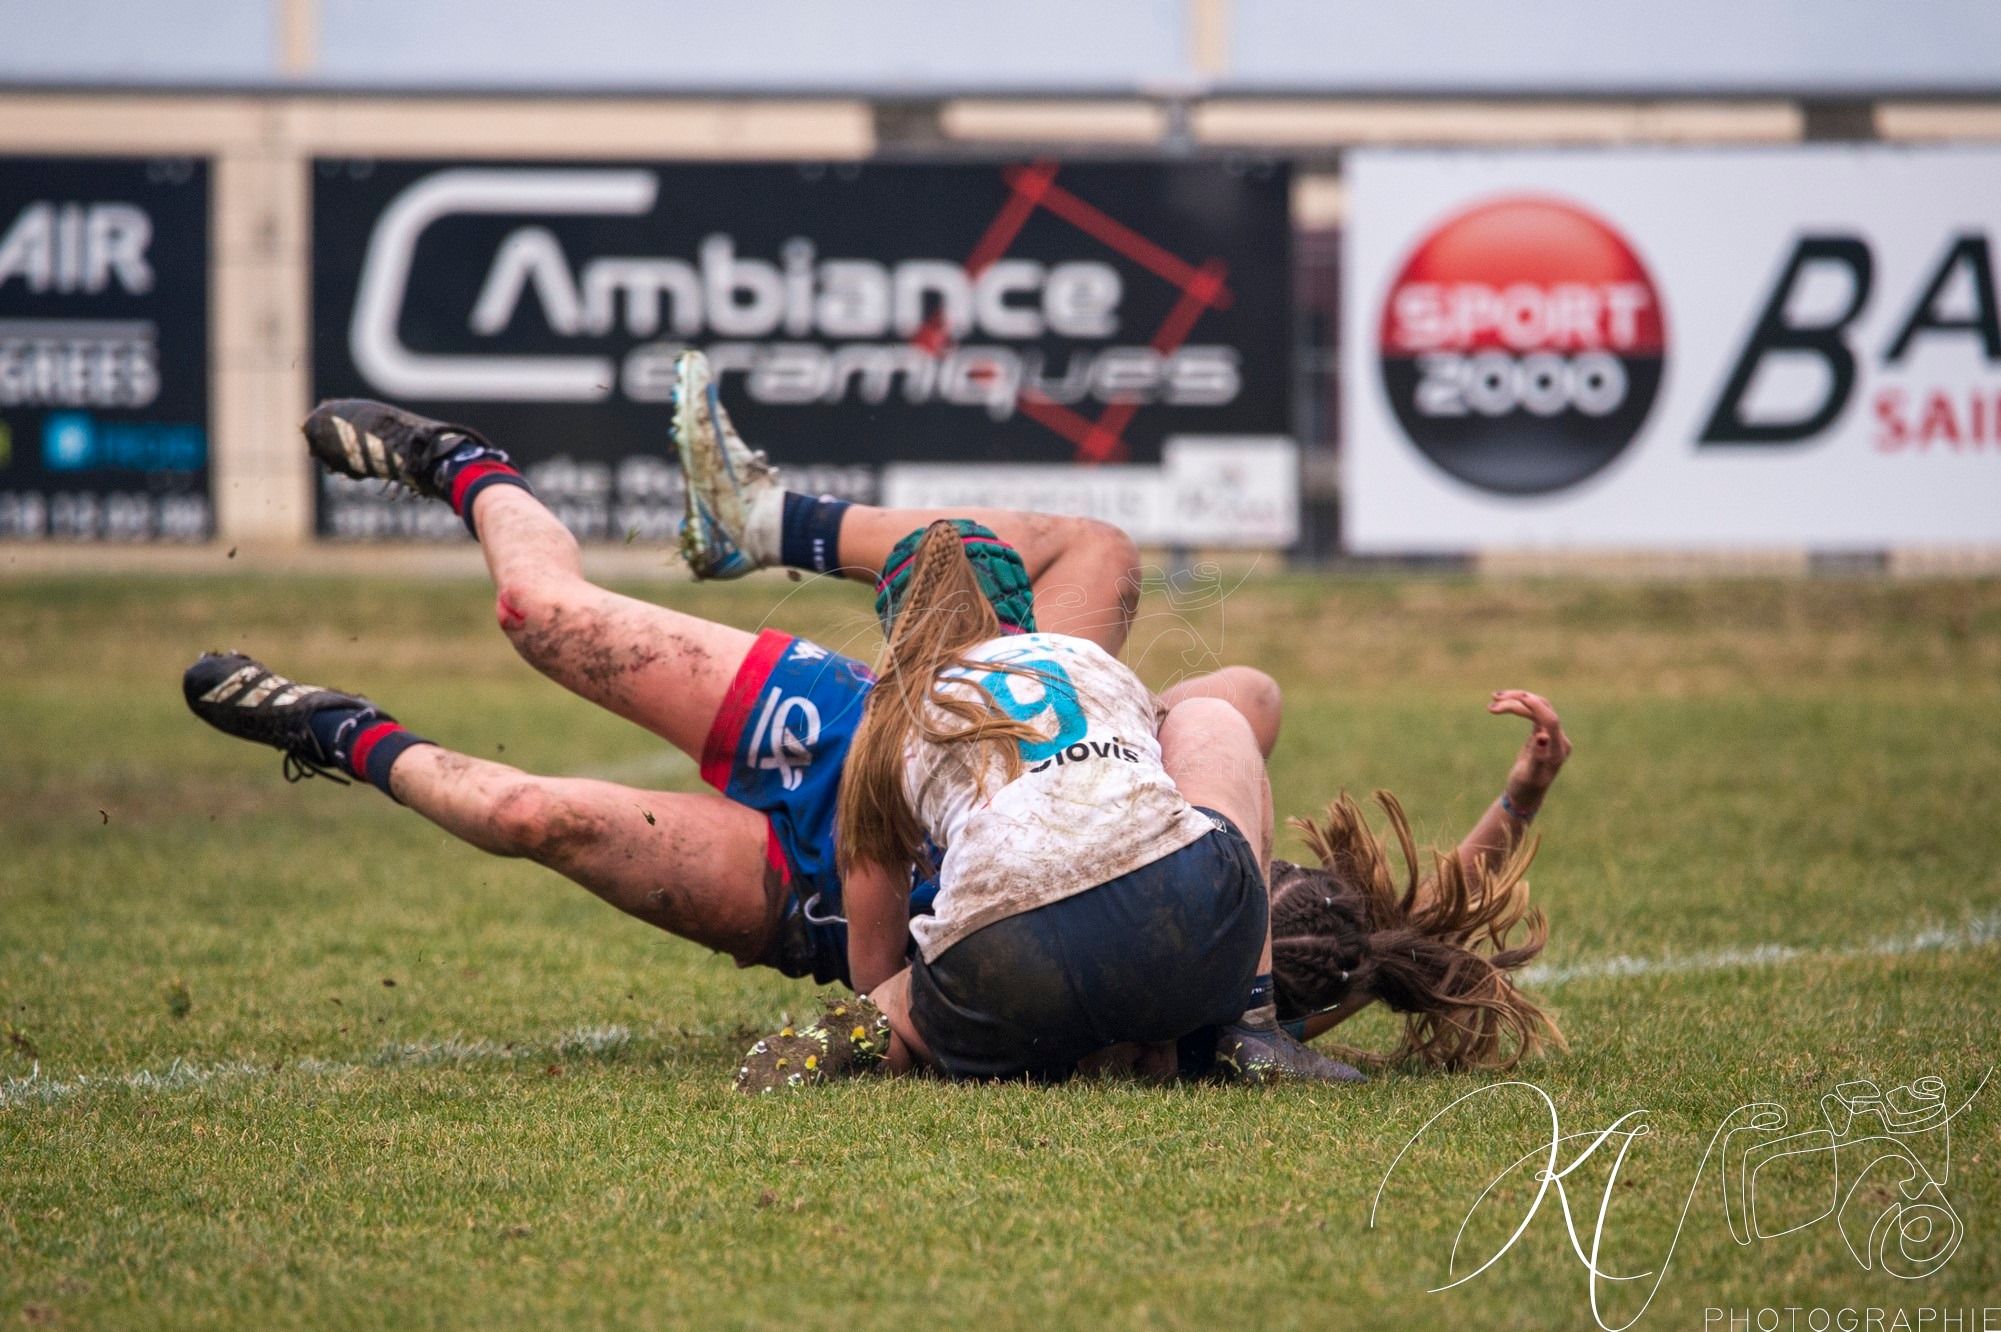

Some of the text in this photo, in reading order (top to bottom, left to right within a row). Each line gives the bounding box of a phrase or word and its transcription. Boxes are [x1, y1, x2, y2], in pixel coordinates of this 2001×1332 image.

[0, 203, 154, 293] AIR
[1392, 281, 1650, 351] SPORT
[1696, 228, 2001, 444] BA
[1414, 351, 1629, 418] 2000
[1873, 389, 2001, 455] SAI
[979, 658, 1089, 763] 9
